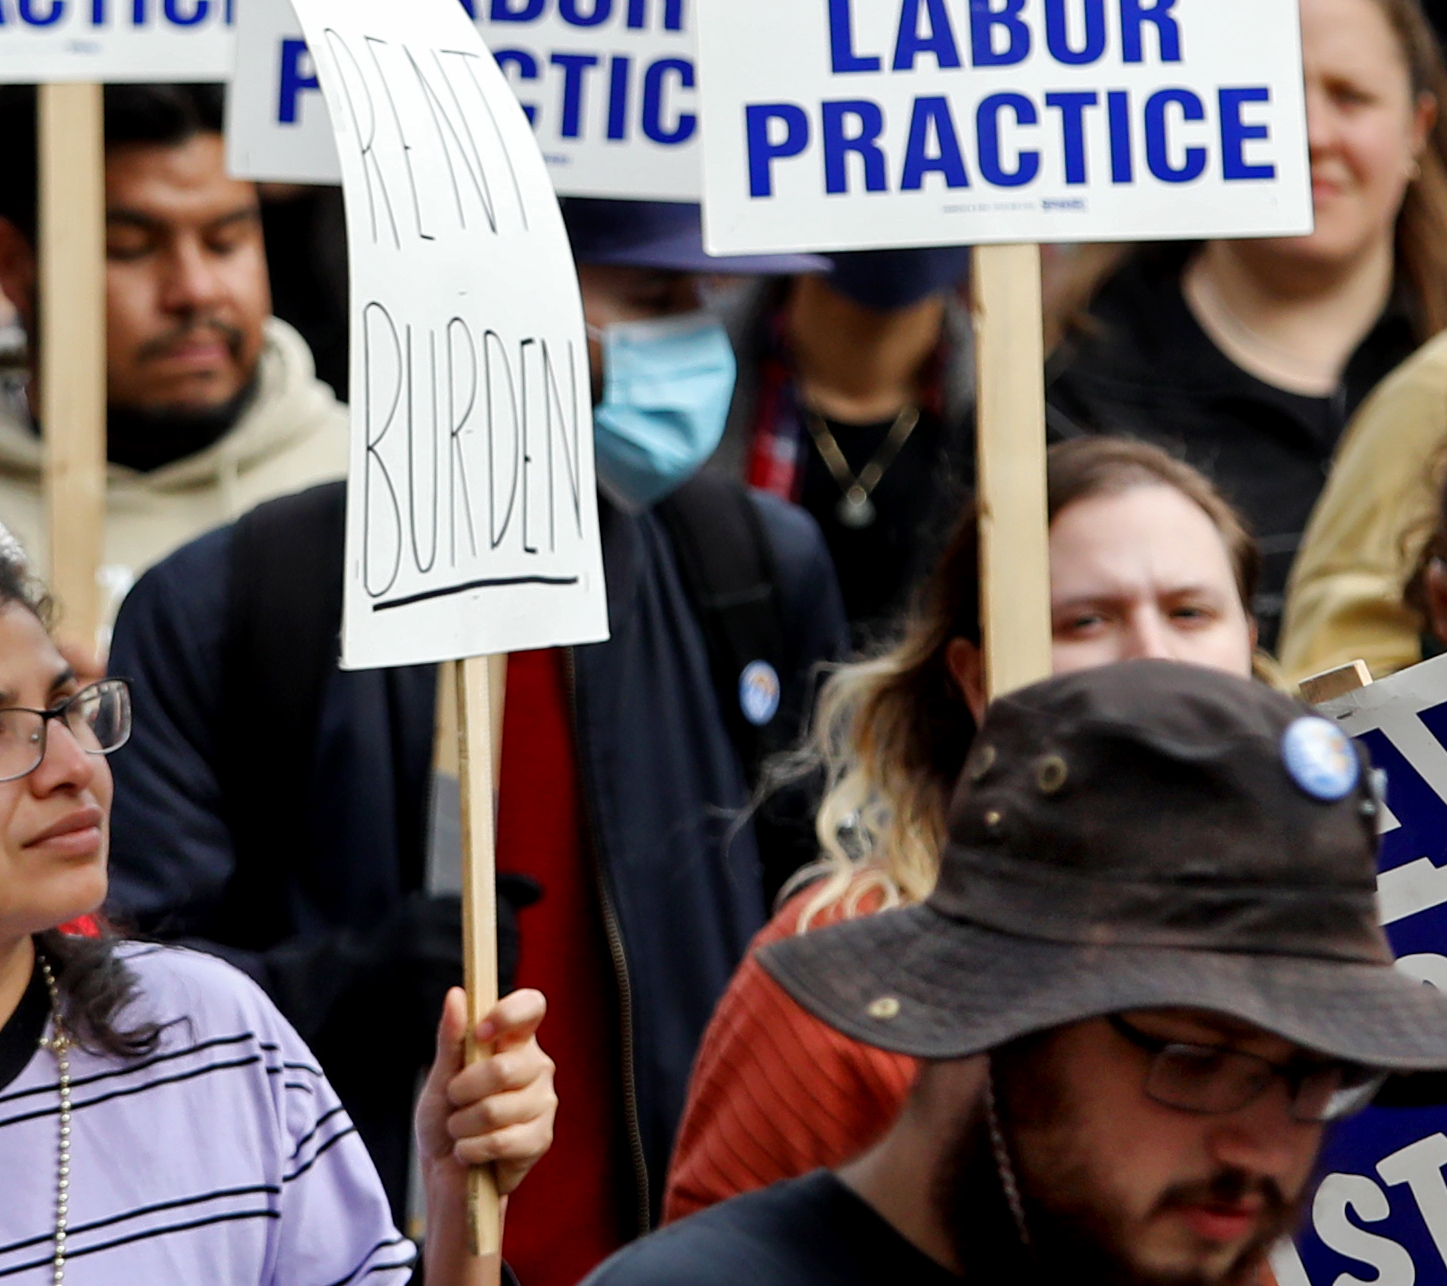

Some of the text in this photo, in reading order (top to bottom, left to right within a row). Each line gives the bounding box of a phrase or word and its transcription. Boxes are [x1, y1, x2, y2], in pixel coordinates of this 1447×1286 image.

[276, 38, 700, 147] PCTIC
[324, 26, 530, 253] RENT
[742, 85, 1278, 200] PRACTICE
[360, 299, 586, 601] BURDEN
